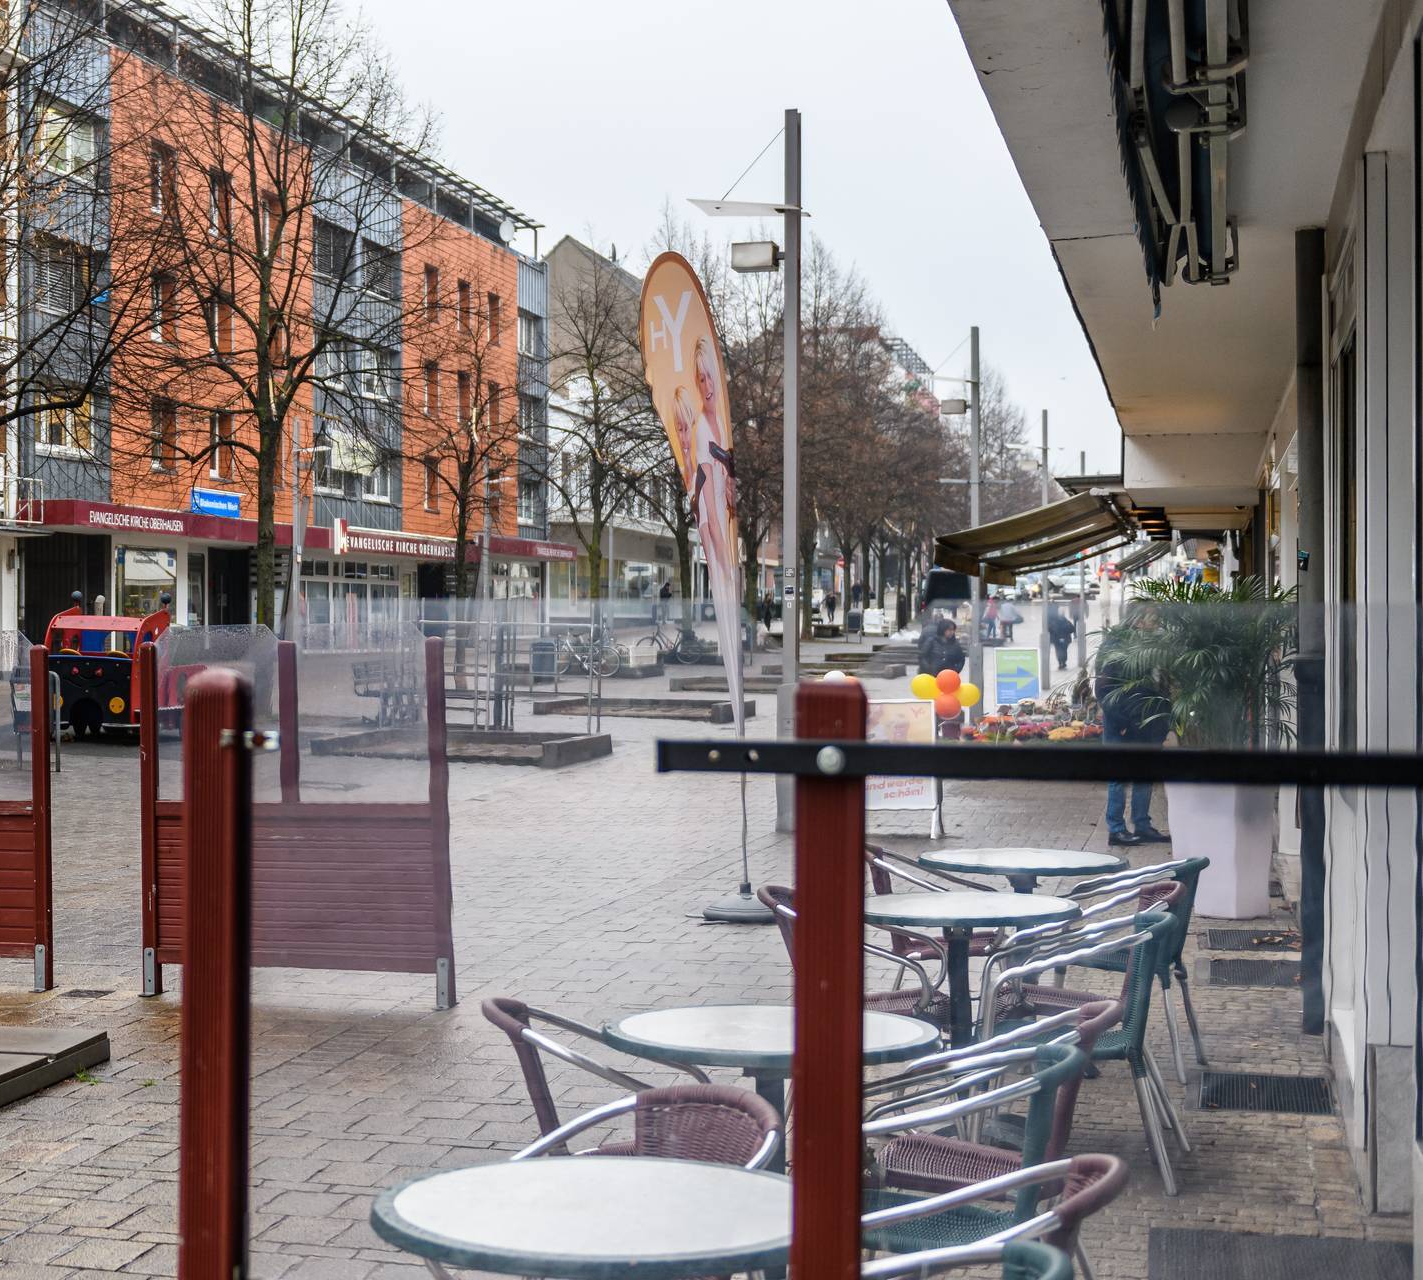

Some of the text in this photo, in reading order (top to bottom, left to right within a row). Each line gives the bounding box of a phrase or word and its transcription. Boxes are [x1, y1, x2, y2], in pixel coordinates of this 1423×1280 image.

[89, 510, 184, 532] EVANGELISCHE KIRCHE OBERHAUSEN
[346, 536, 394, 552] EVANGELISCHE
[395, 541, 417, 554] KIRCHE
